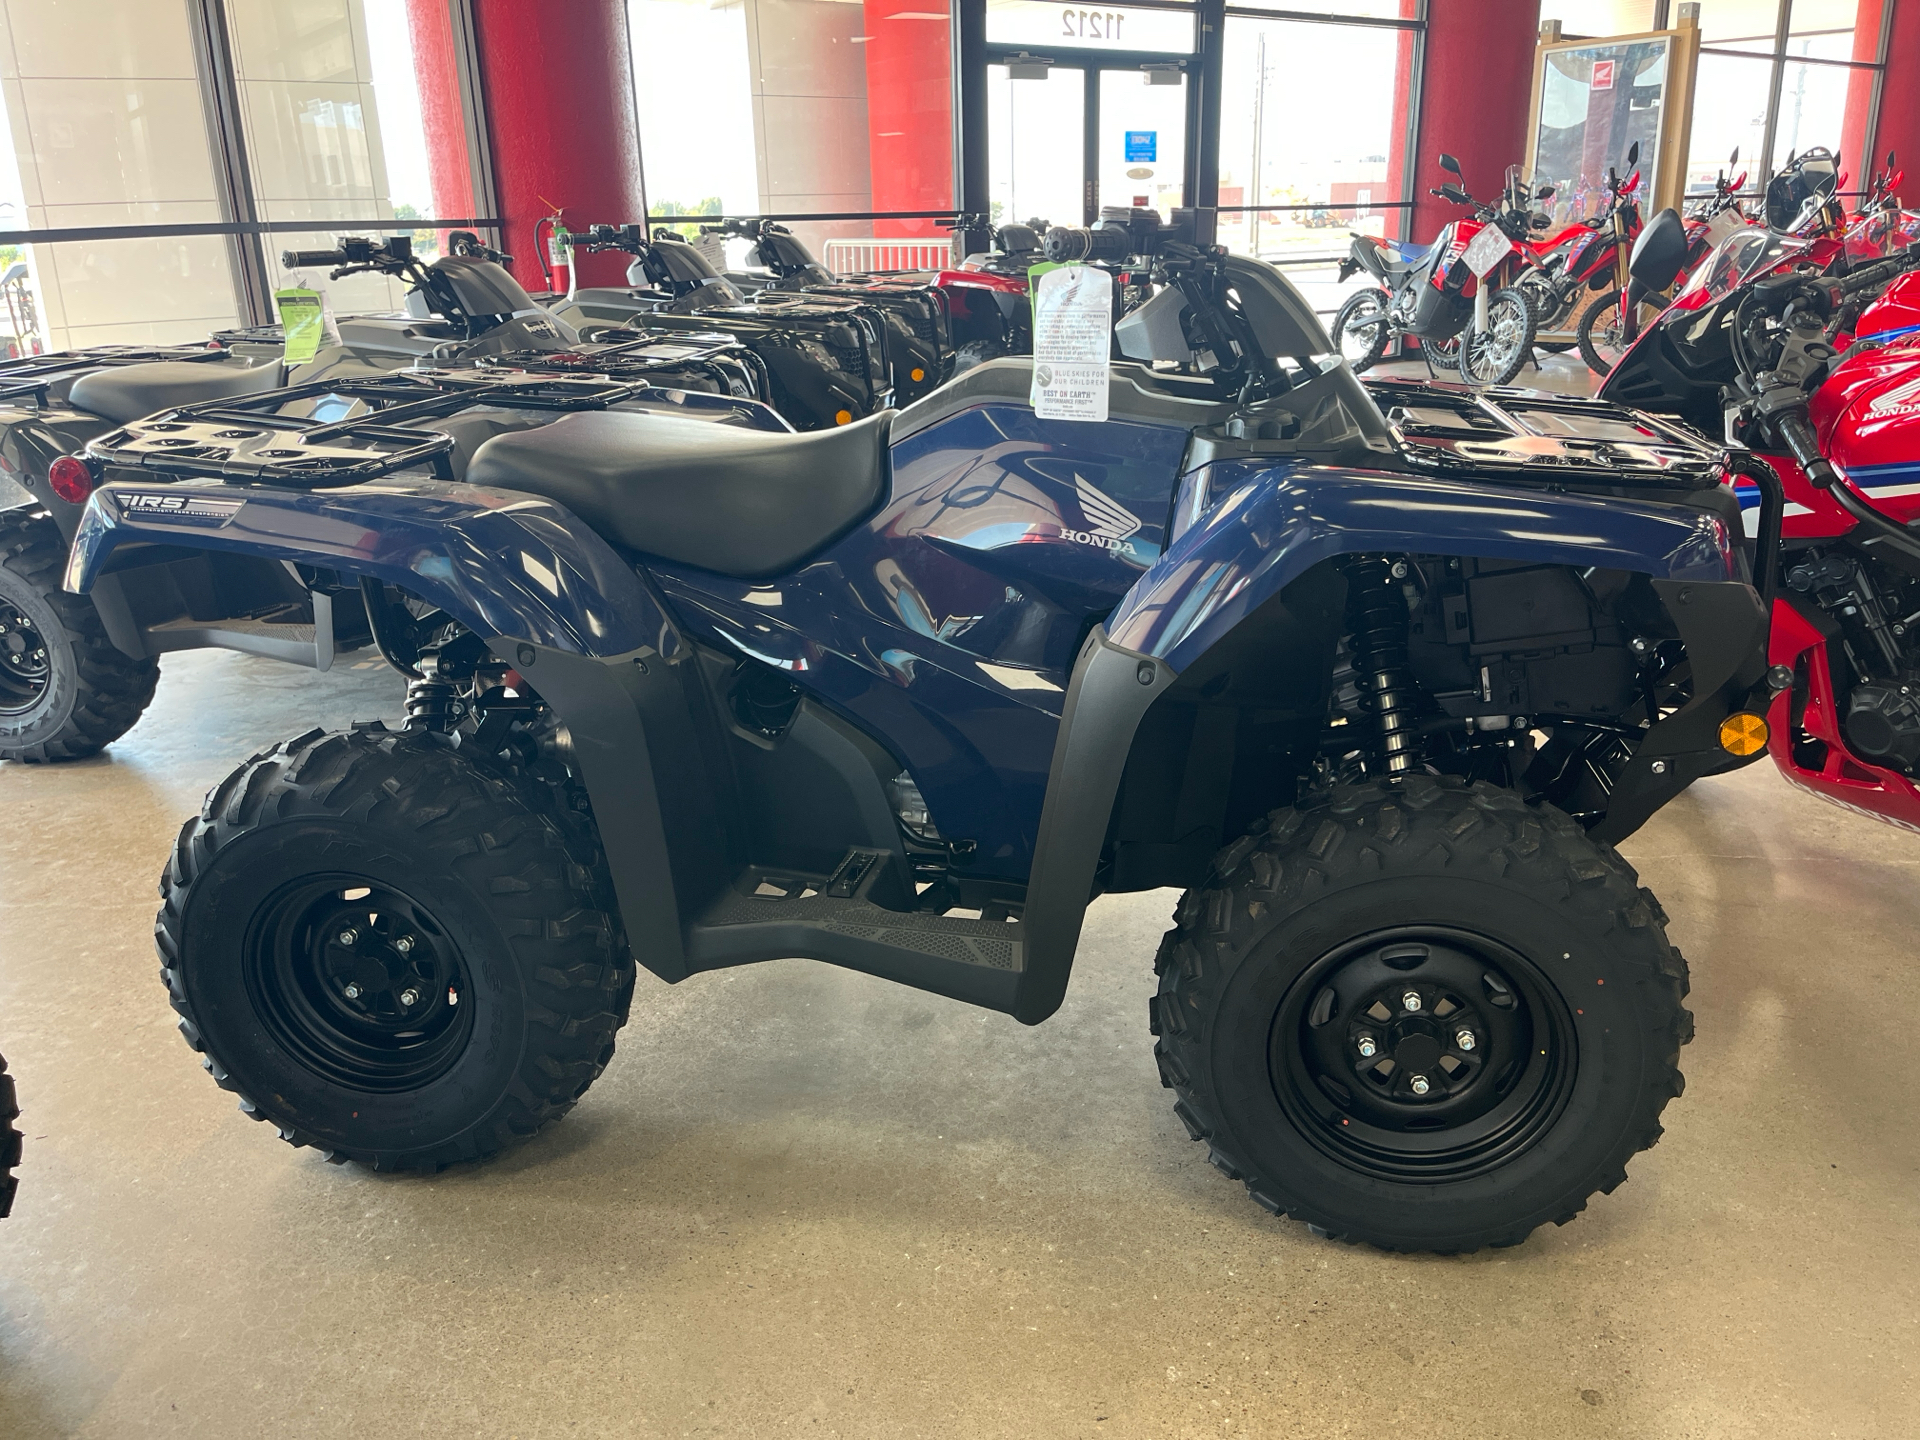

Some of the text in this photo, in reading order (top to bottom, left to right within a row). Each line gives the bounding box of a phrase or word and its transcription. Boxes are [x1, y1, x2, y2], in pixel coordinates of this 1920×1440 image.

[1043, 389, 1058, 397] BEST
[1060, 390, 1067, 398] ON
[130, 495, 185, 509] IRS
[1058, 528, 1137, 555] HONDA
